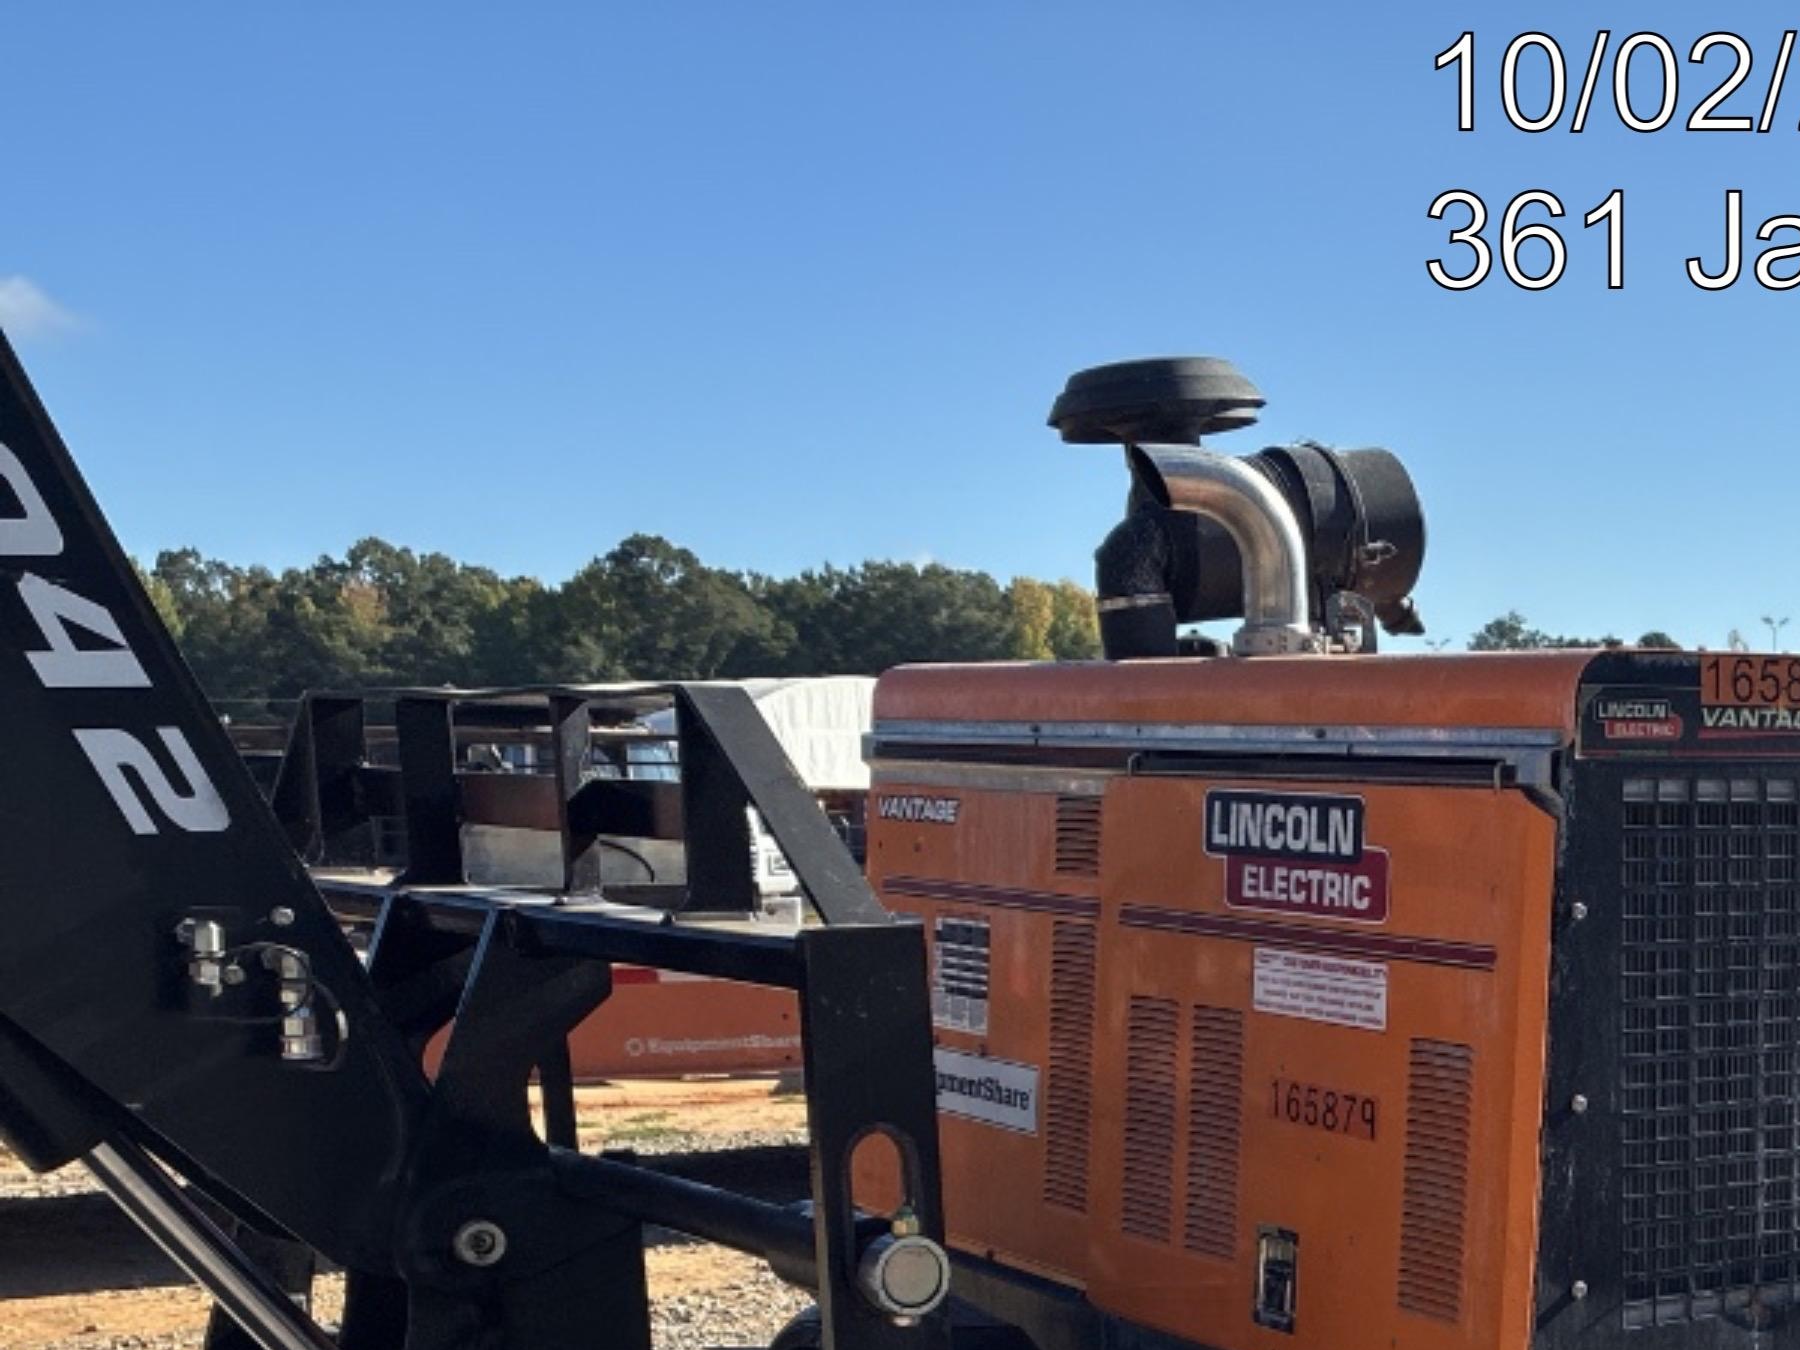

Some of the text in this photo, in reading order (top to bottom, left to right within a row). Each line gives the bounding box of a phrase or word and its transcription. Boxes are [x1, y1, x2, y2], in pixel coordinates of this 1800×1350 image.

[1598, 702, 1667, 719] LINCOLN
[1613, 721, 1676, 737] ELECTRIC
[879, 796, 959, 823] VANTAGE
[1211, 800, 1355, 856] LINCOLN
[1242, 863, 1372, 910] ELECTRIC
[1271, 1079, 1376, 1141] 165879
